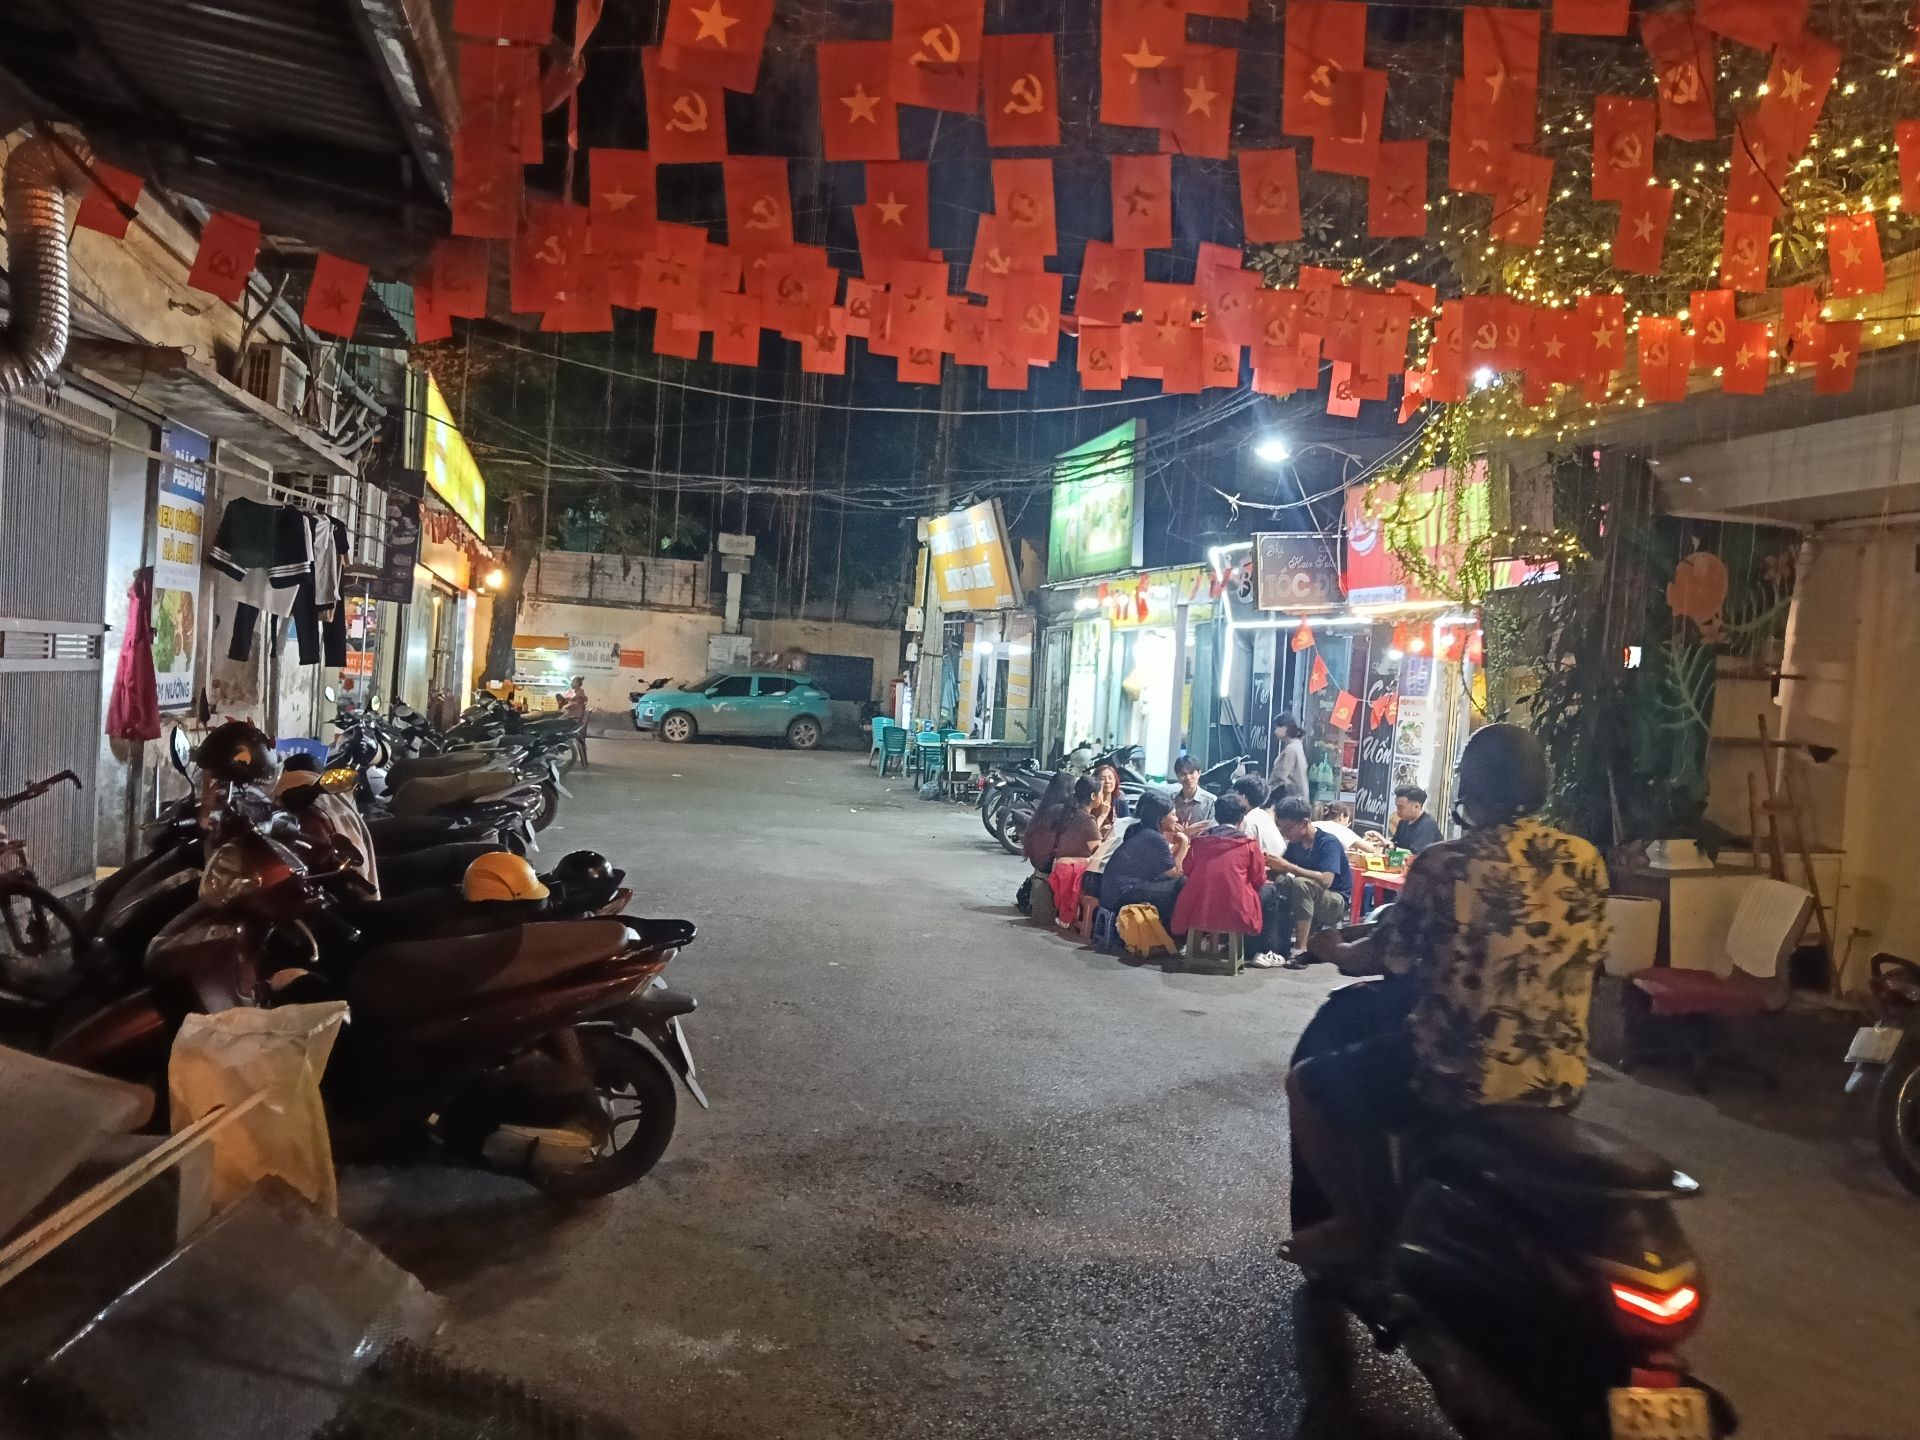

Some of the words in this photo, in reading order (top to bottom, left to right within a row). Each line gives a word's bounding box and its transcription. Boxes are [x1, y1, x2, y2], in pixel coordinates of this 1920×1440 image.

[1264, 567, 1311, 598] TÓC
[1363, 735, 1392, 765] Uốn
[1356, 787, 1387, 822] Nhuộm
